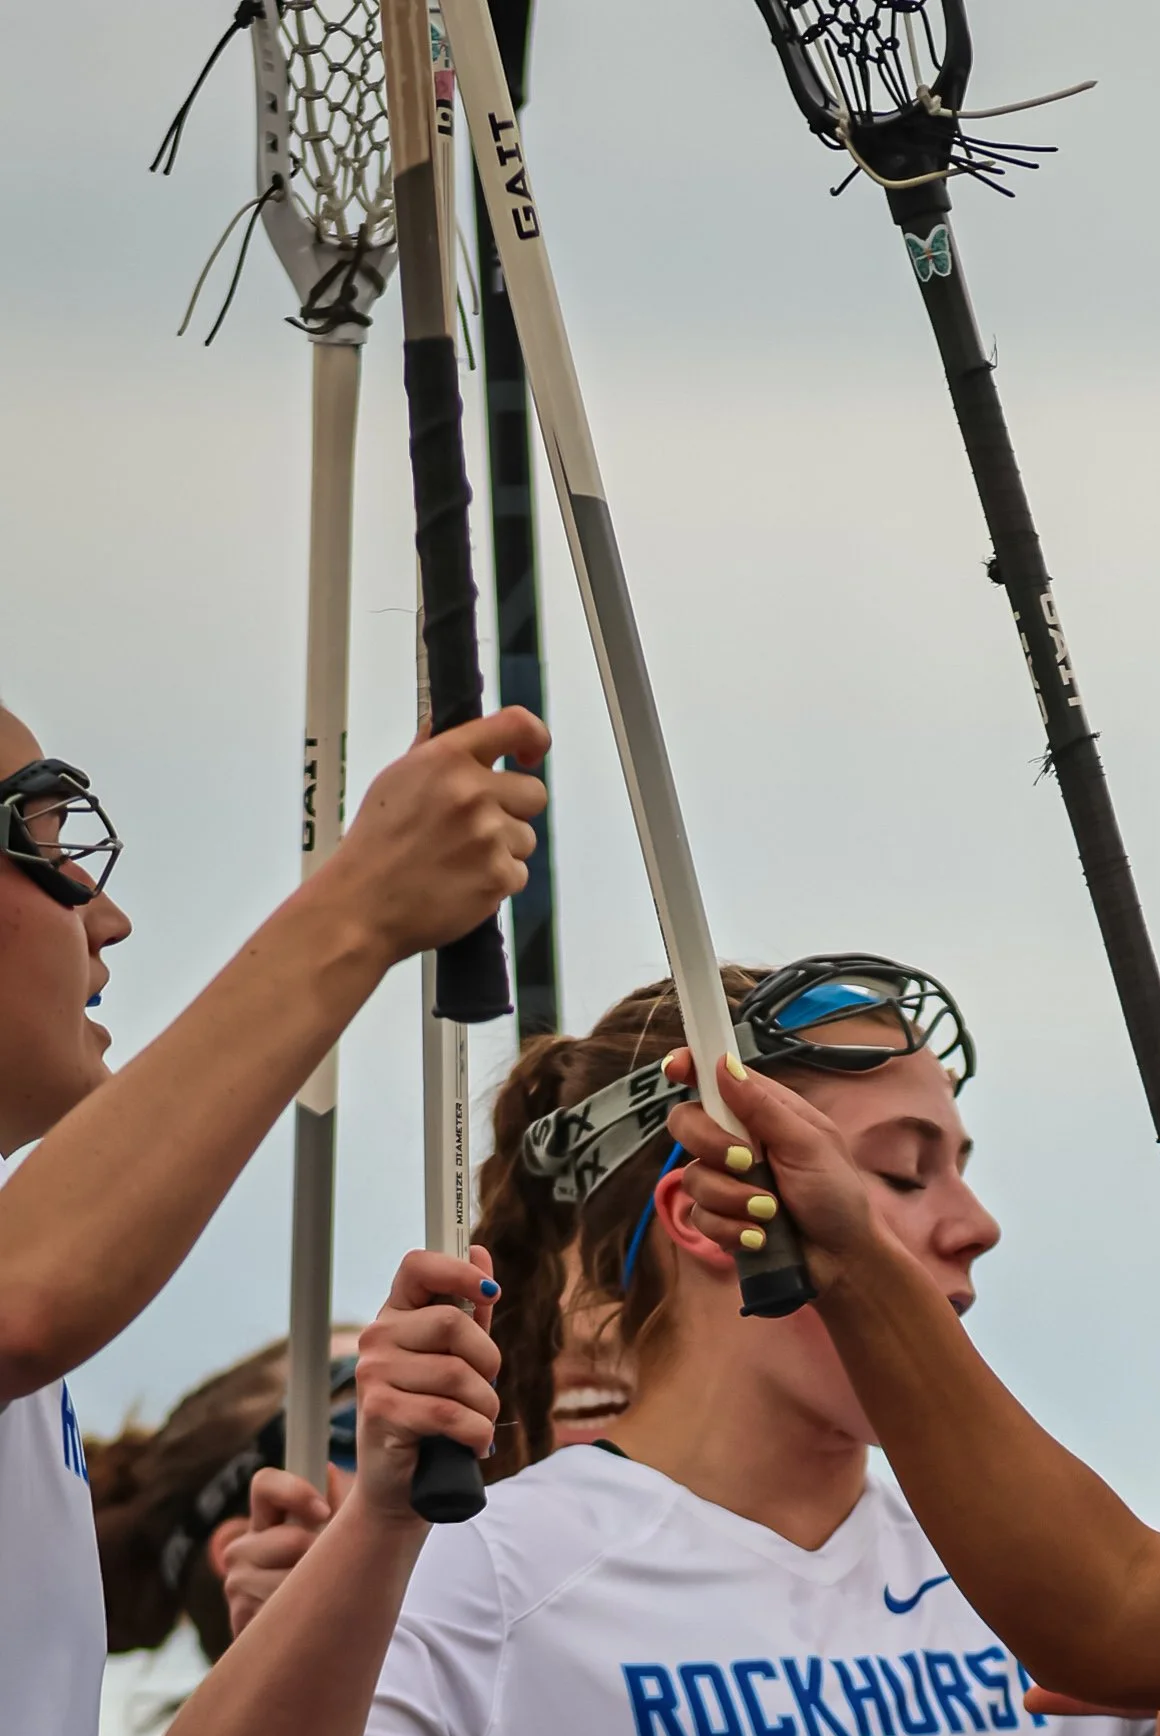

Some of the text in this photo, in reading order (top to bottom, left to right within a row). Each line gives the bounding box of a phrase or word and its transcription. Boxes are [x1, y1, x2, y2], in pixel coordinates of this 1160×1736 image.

[487, 111, 541, 241] GAIT
[455, 1102, 464, 1226] MIDSIZE DIAMETER
